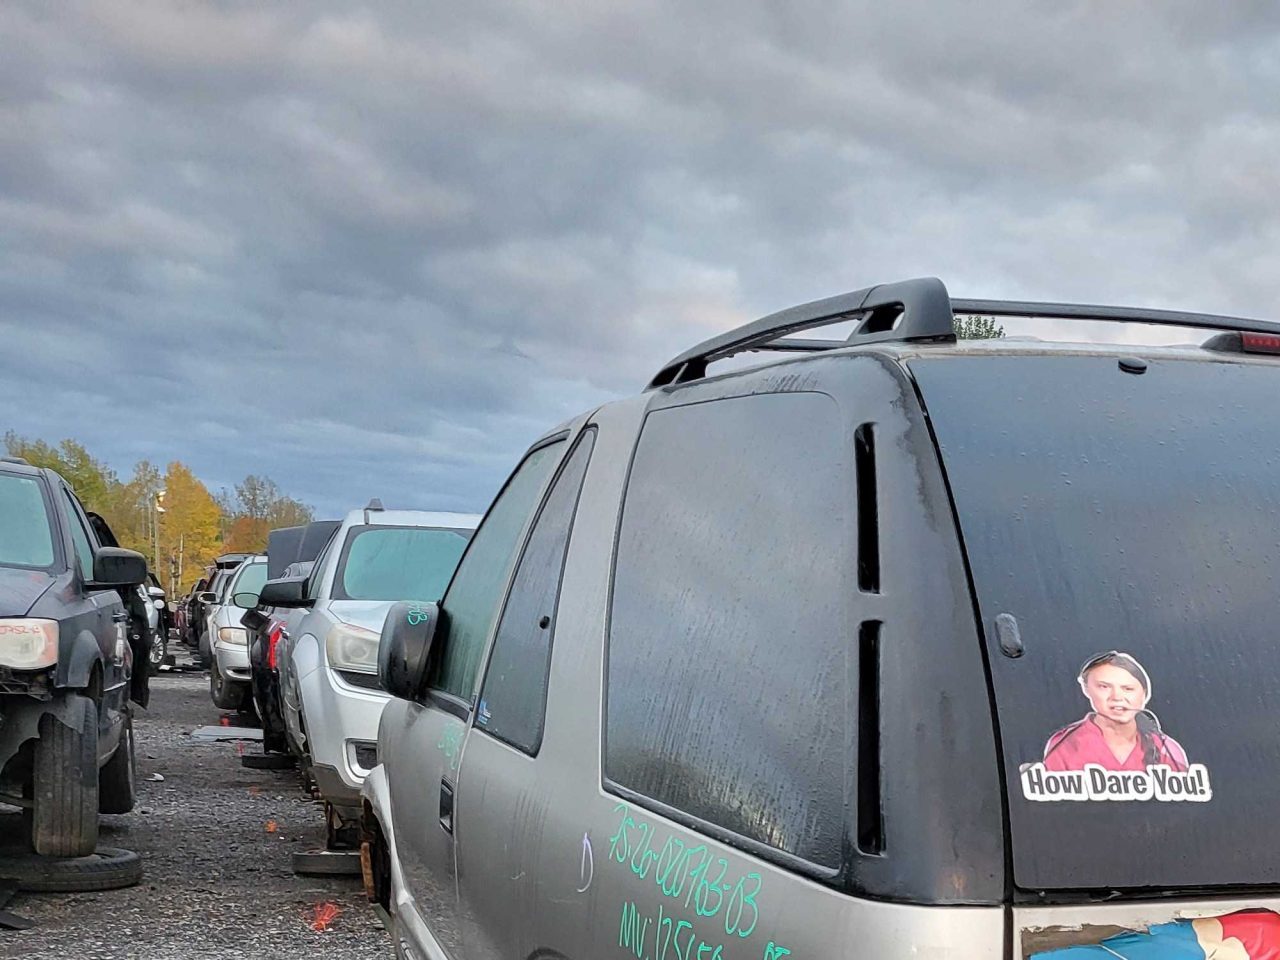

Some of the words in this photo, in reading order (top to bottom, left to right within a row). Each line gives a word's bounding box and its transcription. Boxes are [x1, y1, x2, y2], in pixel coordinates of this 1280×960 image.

[1026, 767, 1084, 796] How
[1089, 767, 1148, 795] Dare
[1151, 768, 1207, 796] You!
